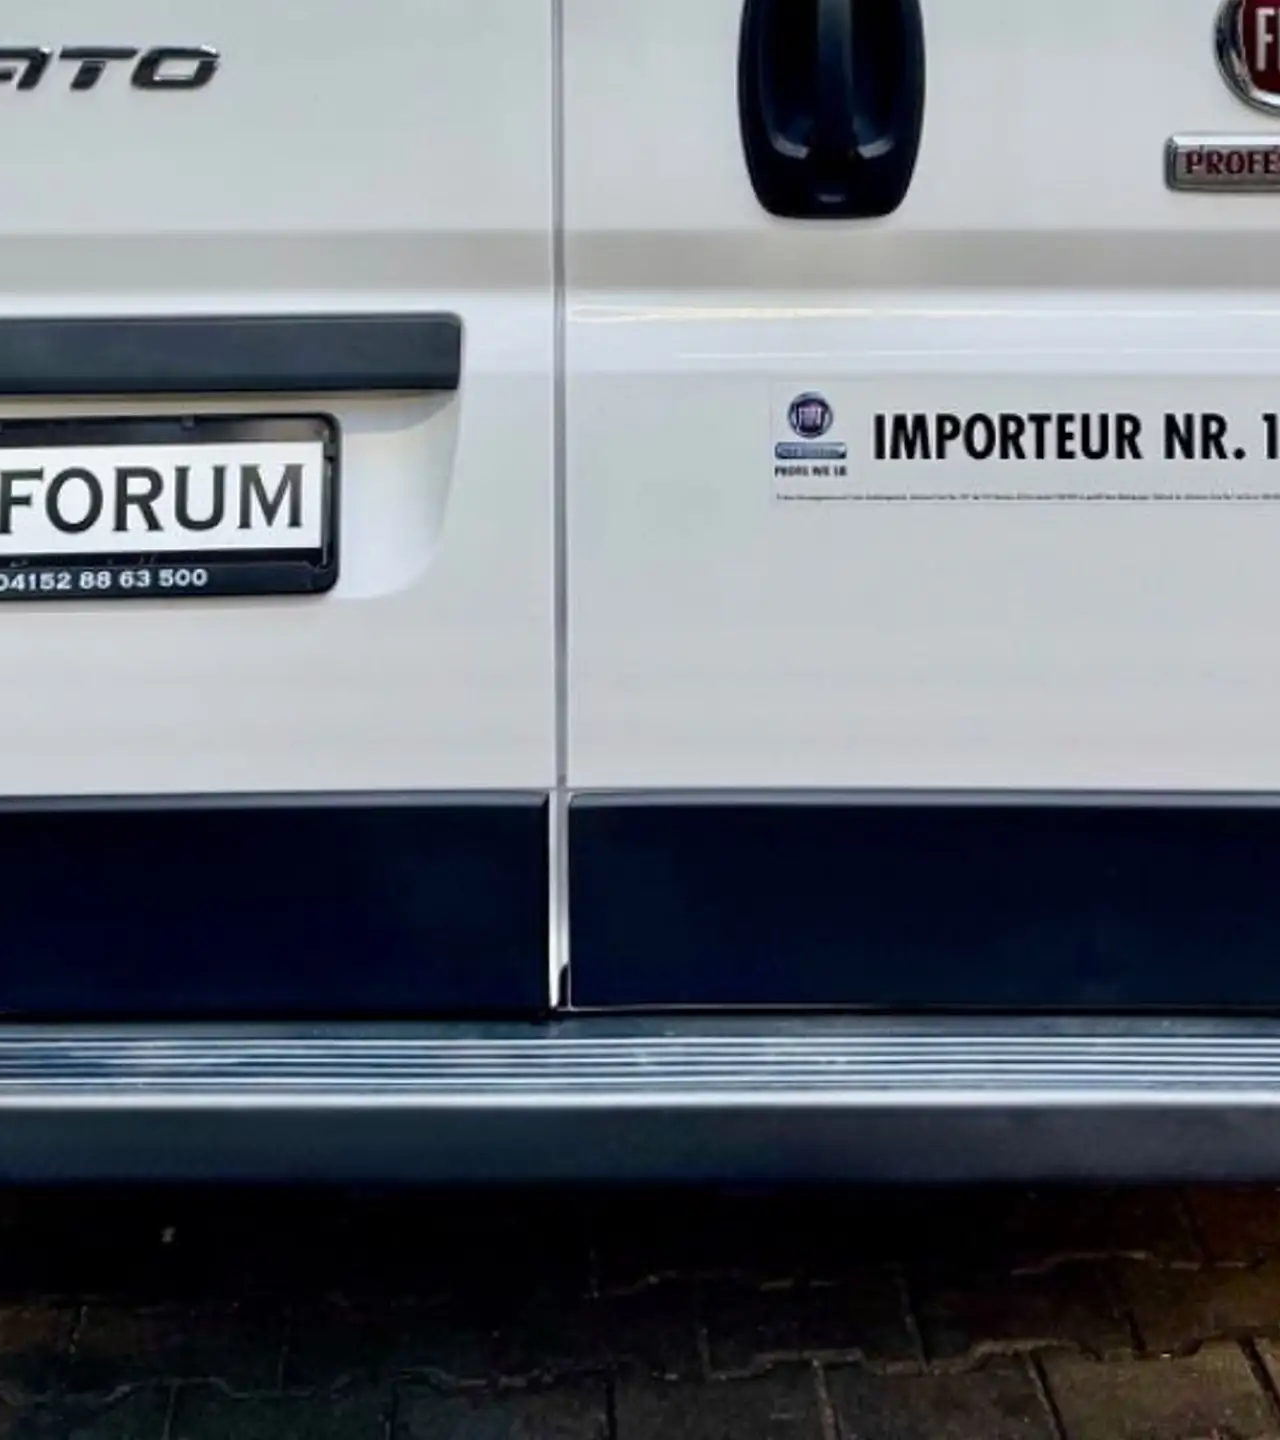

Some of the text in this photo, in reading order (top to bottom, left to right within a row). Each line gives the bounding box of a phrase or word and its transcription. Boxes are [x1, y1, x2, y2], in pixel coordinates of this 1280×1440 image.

[873, 412, 1144, 461] IMPORTEUR
[1163, 412, 1247, 461] NR.
[1261, 412, 1279, 461] 1
[79, 570, 113, 590] 88
[119, 569, 152, 589] 63
[158, 567, 209, 588] 500
